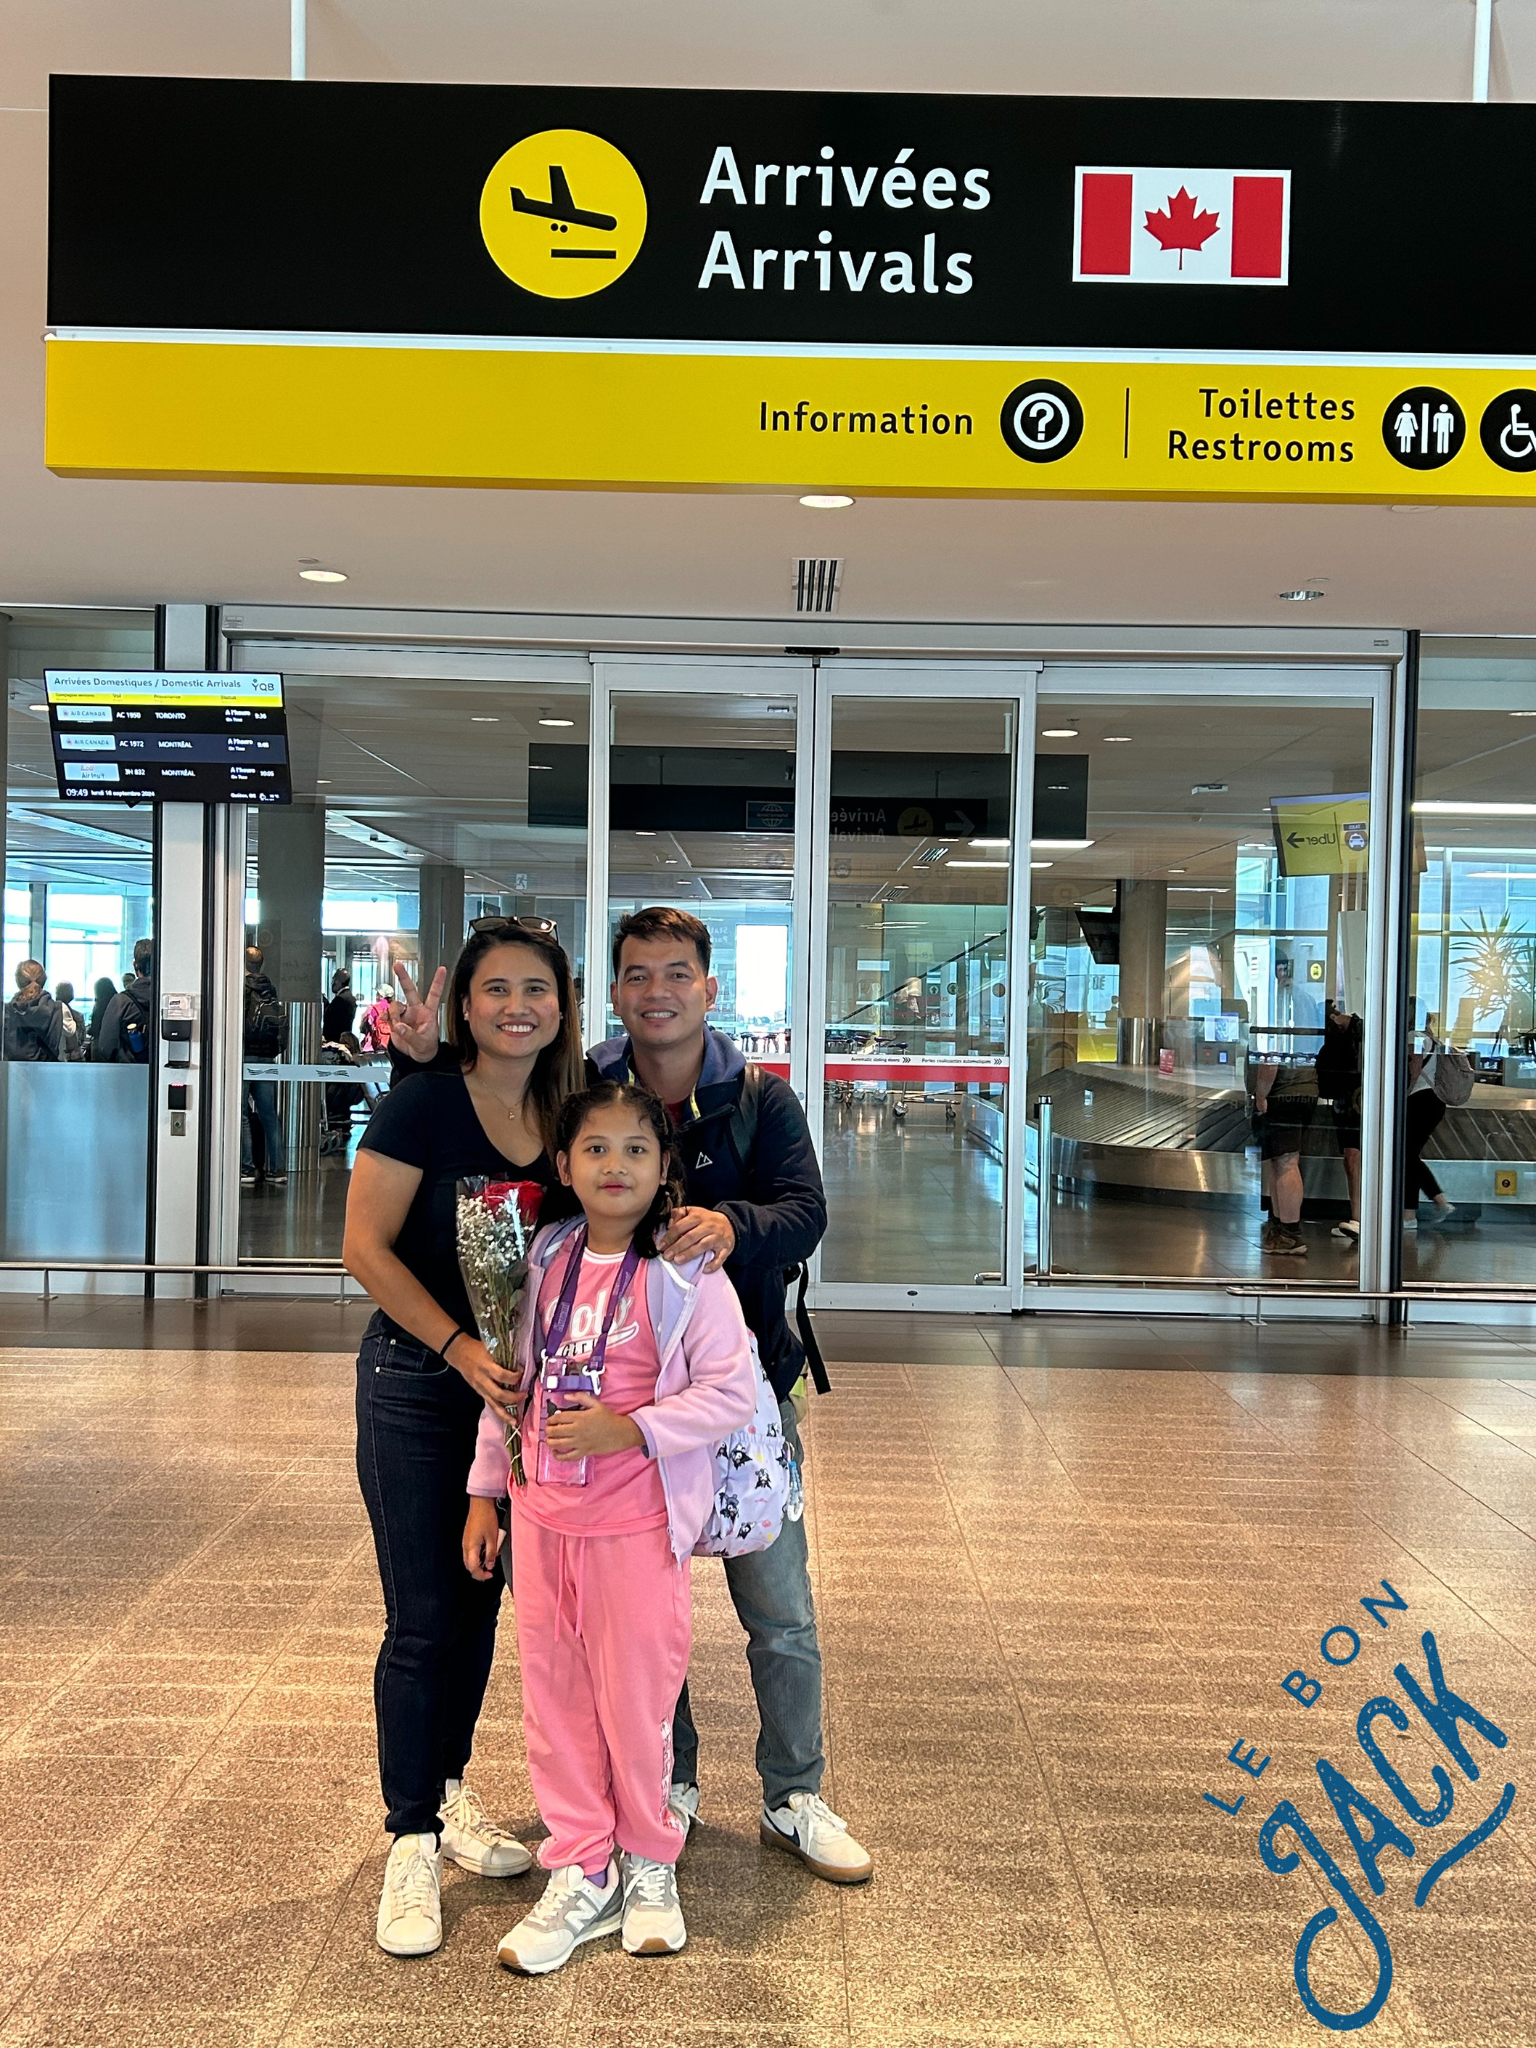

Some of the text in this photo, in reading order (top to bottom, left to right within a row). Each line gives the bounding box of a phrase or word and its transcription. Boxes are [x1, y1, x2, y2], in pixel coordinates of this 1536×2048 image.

[700, 146, 991, 211] Arrivées
[698, 230, 974, 295] Arrivals
[1198, 388, 1356, 421] Toilettes
[759, 401, 974, 435] Information
[1167, 429, 1355, 462] Restrooms
[54, 677, 91, 686] Arrivées
[93, 678, 153, 688] Domestiques
[162, 679, 204, 688] Domestic
[206, 679, 242, 688] Arrivals
[251, 681, 275, 692] YQB
[116, 711, 126, 719] AC
[129, 740, 145, 748] 1972
[158, 740, 193, 748] MONTRÉAL
[161, 768, 196, 777] MONTRÉAL
[66, 788, 89, 797] 09:49
